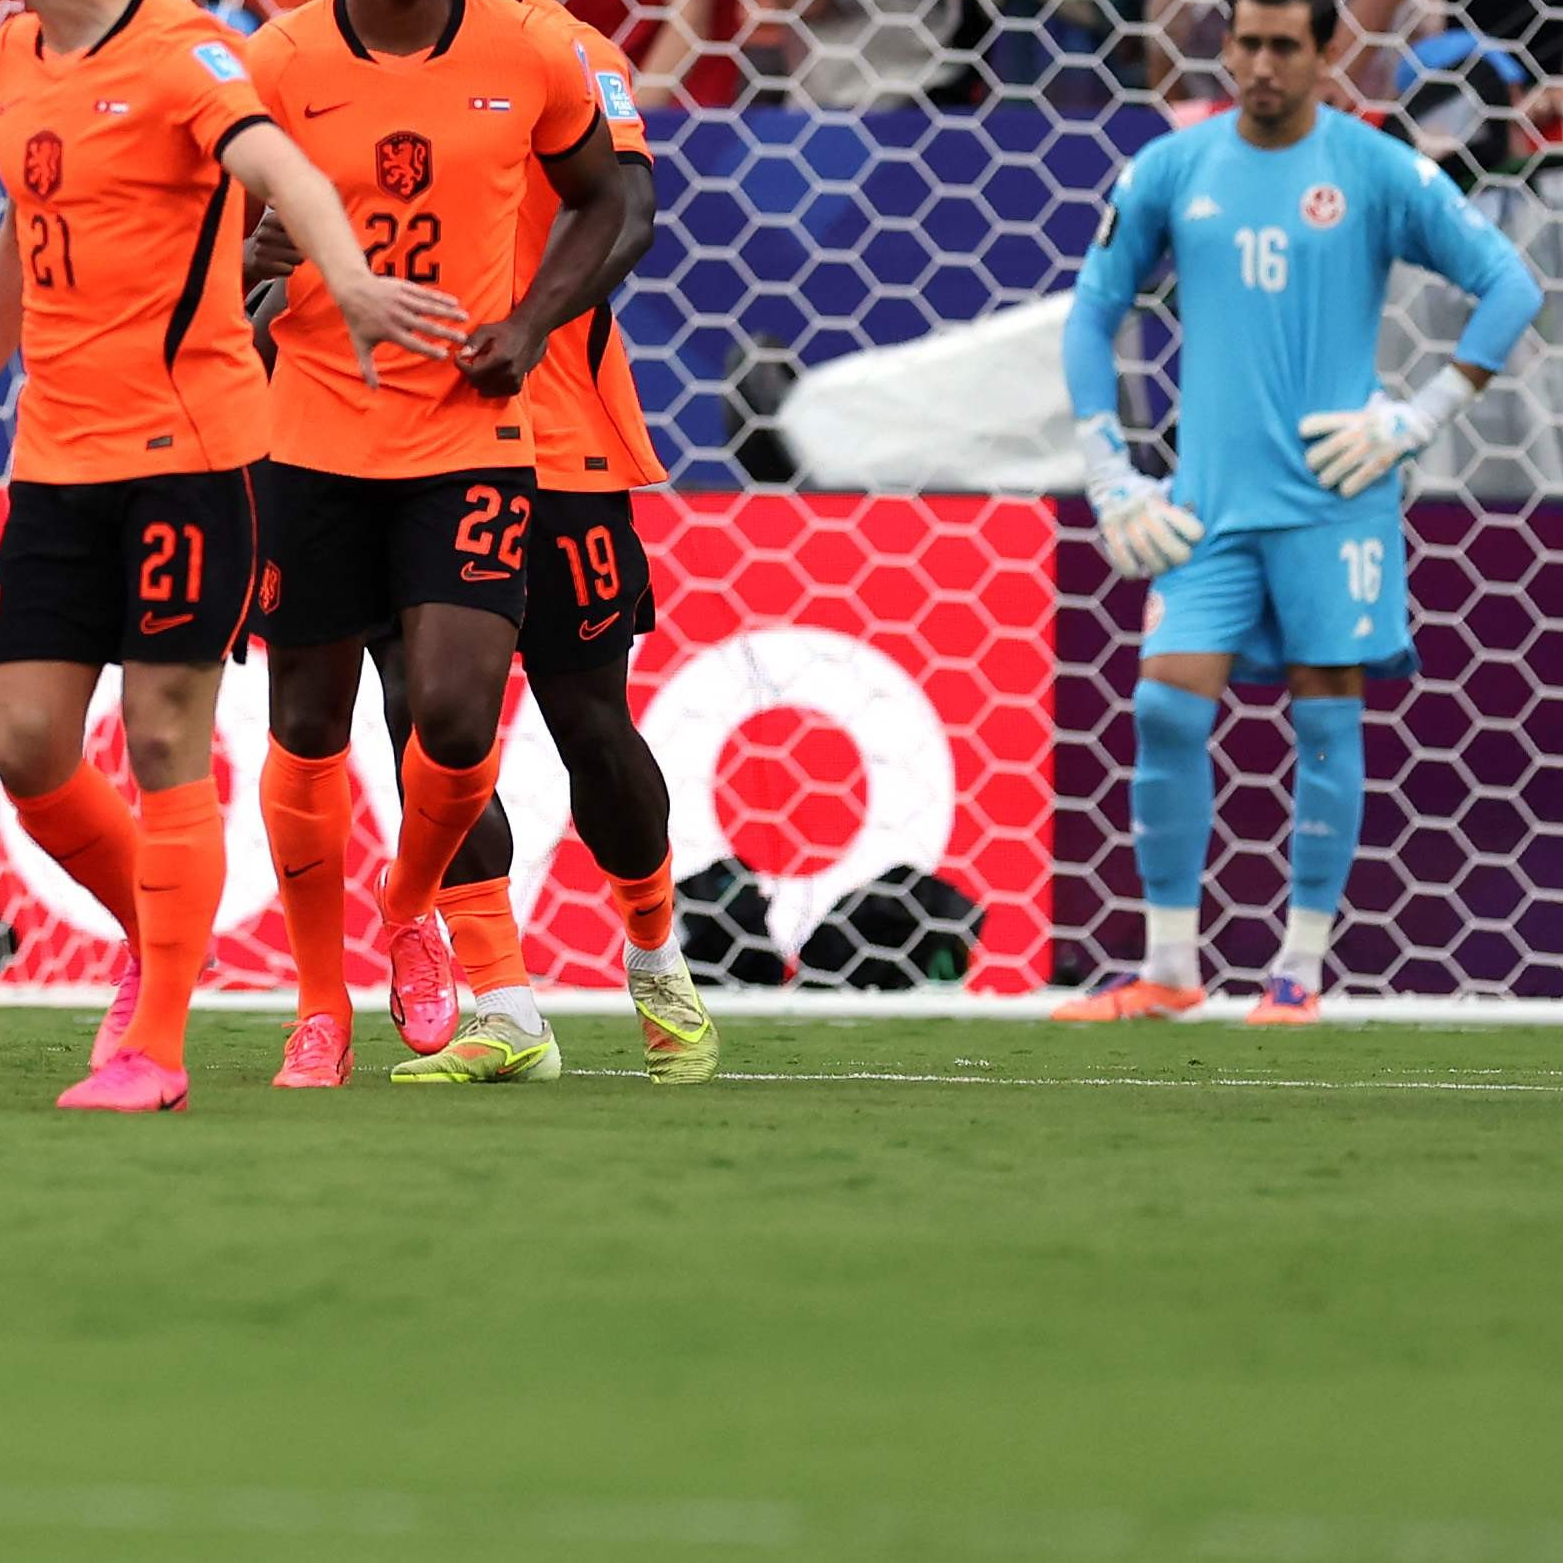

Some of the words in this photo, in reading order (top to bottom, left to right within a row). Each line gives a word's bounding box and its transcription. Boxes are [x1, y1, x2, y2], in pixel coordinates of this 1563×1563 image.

[30, 213, 77, 289] 21
[362, 212, 442, 286] 22
[1234, 226, 1290, 294] 16
[138, 521, 205, 603] 21
[453, 483, 532, 571] 22
[555, 524, 621, 607] 19
[1338, 537, 1385, 604] 16
